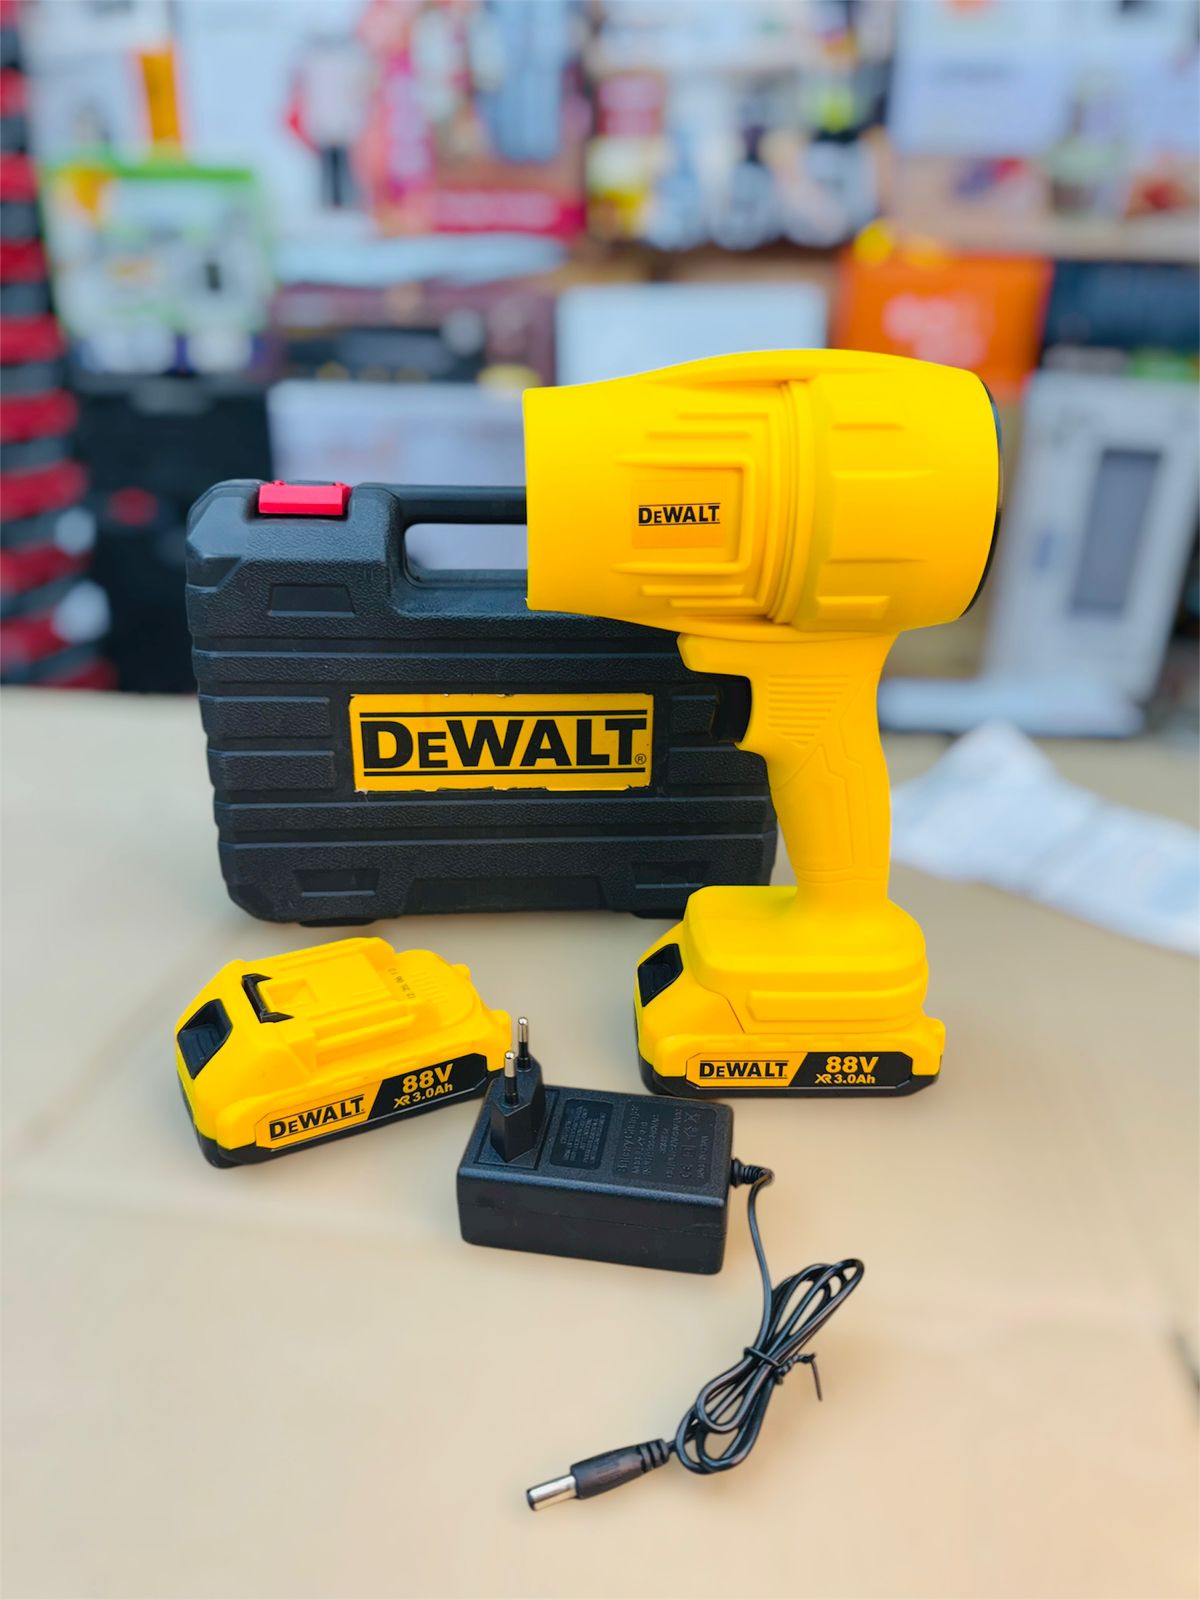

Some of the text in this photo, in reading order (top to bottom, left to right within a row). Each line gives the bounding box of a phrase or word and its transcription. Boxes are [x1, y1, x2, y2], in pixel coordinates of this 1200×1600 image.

[638, 504, 720, 525] DEWALT
[699, 1061, 788, 1078] DEWALT
[825, 1056, 879, 1073] 88V
[403, 1064, 454, 1093] 88V
[834, 1073, 877, 1085] 3.0Ah
[412, 1083, 454, 1103] 3.0Ah
[269, 1097, 364, 1139] DEWALT
